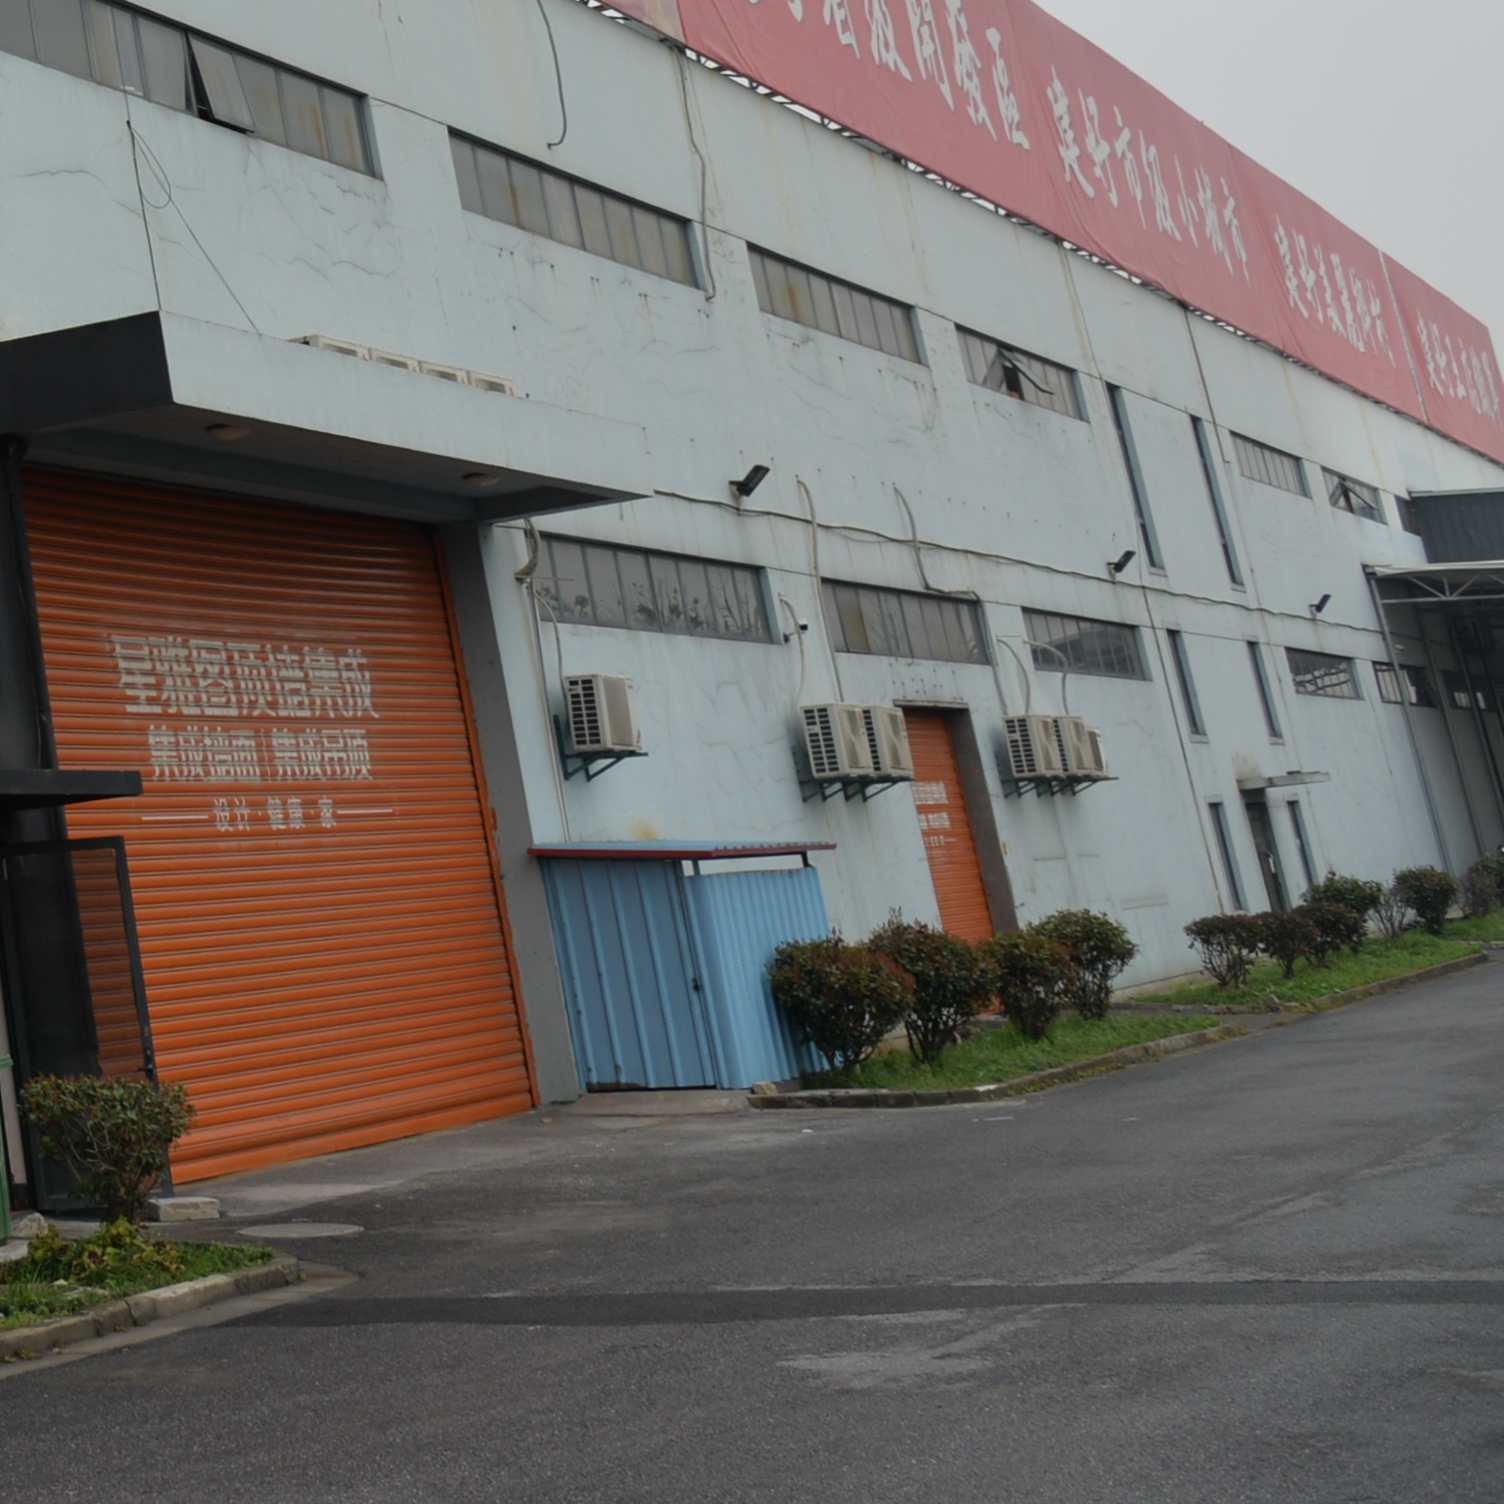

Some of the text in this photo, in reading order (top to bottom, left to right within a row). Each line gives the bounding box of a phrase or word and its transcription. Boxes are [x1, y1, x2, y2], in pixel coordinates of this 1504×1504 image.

[111, 635, 379, 718] 星雅图顶墙集成
